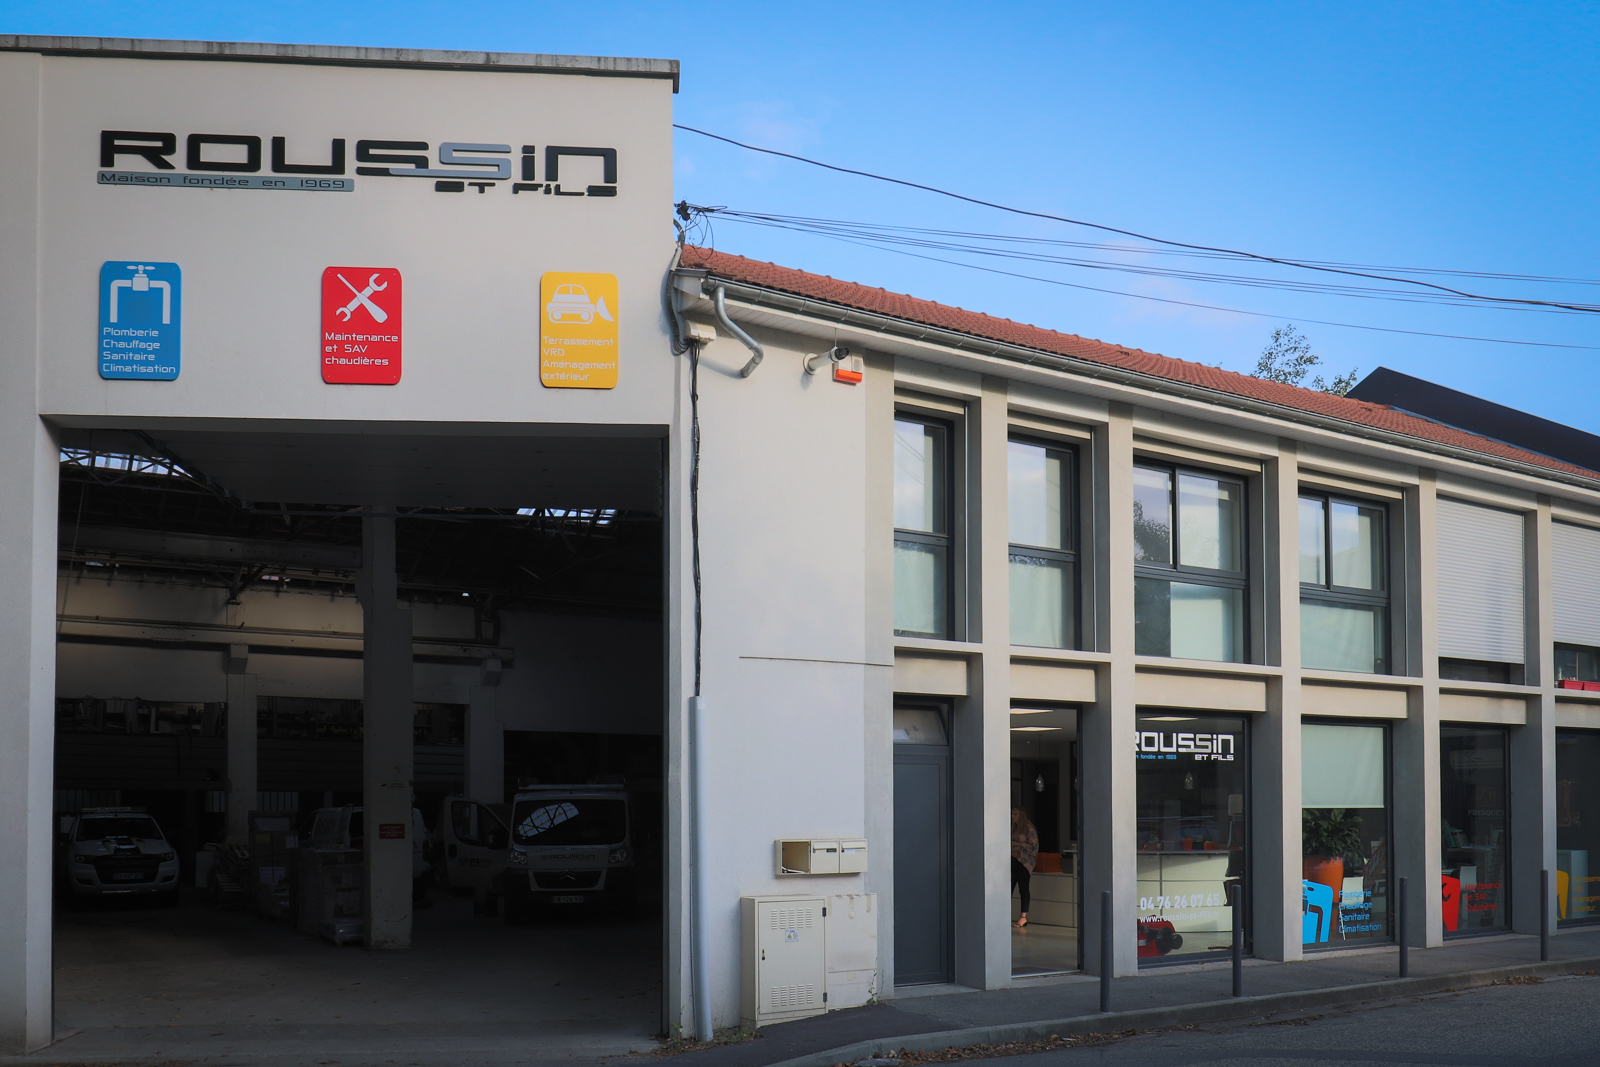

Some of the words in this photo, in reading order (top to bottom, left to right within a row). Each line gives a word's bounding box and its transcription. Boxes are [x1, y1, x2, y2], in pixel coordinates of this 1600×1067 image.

[101, 173, 171, 184] Maison
[183, 176, 249, 186] fondée
[262, 179, 286, 187] en
[300, 179, 345, 189] 1969
[103, 327, 159, 337] Plomberie
[325, 332, 399, 342] Maintenance
[103, 339, 160, 351] Chauffage
[543, 336, 614, 346] Terrassement
[325, 344, 338, 353] et
[344, 344, 368, 353] SAV
[543, 348, 565, 356] VRD
[103, 351, 156, 361] Sanitaire
[325, 356, 389, 366] chaudières
[103, 363, 176, 373] Climatisation
[543, 360, 616, 371] Aménagement
[543, 372, 590, 381] extérieur
[1338, 888, 1372, 899] Plomberie
[1140, 896, 1155, 911] 04
[1157, 895, 1171, 909] 76
[1174, 894, 1188, 909] 26
[1190, 893, 1204, 908] 07
[1206, 893, 1220, 907] 65
[1338, 900, 1373, 911] Chauffage
[1139, 910, 1220, 923] www.roussin-et-fils.fr
[1338, 911, 1370, 922] Sanitaire
[1338, 922, 1383, 934] Climatisation
